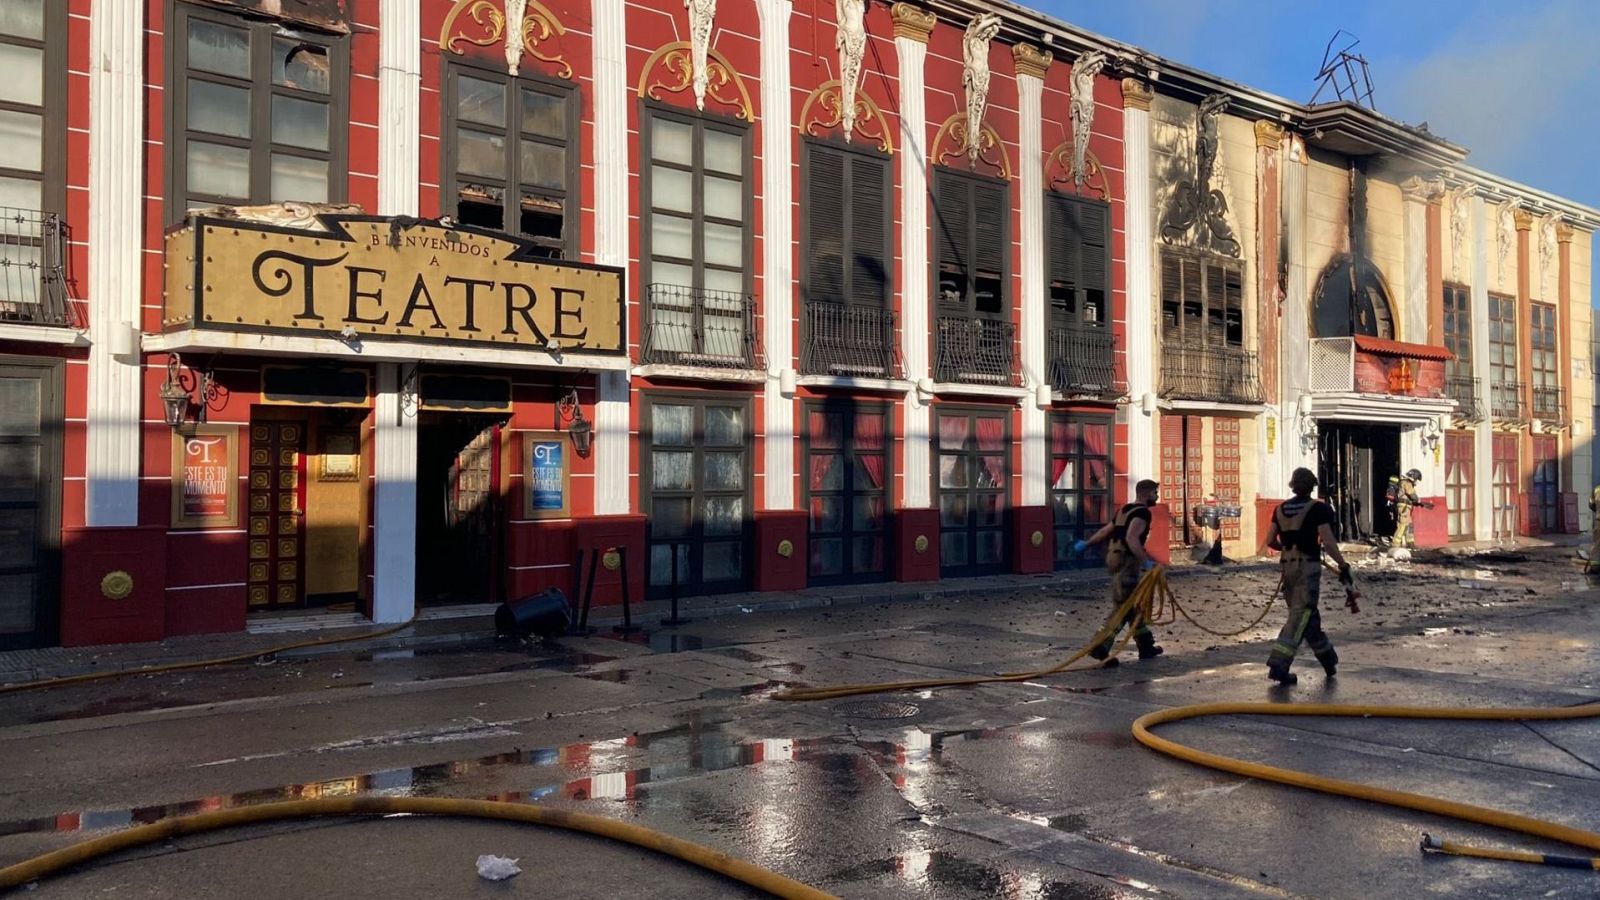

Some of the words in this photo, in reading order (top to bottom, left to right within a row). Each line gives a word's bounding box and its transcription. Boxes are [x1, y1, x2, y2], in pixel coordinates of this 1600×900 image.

[371, 234, 490, 258] BINVENIDOS
[429, 256, 440, 267] A
[252, 250, 588, 349] TEATRE
[205, 466, 215, 480] ES
[217, 466, 227, 480] TU
[184, 480, 226, 495] MOMENTO
